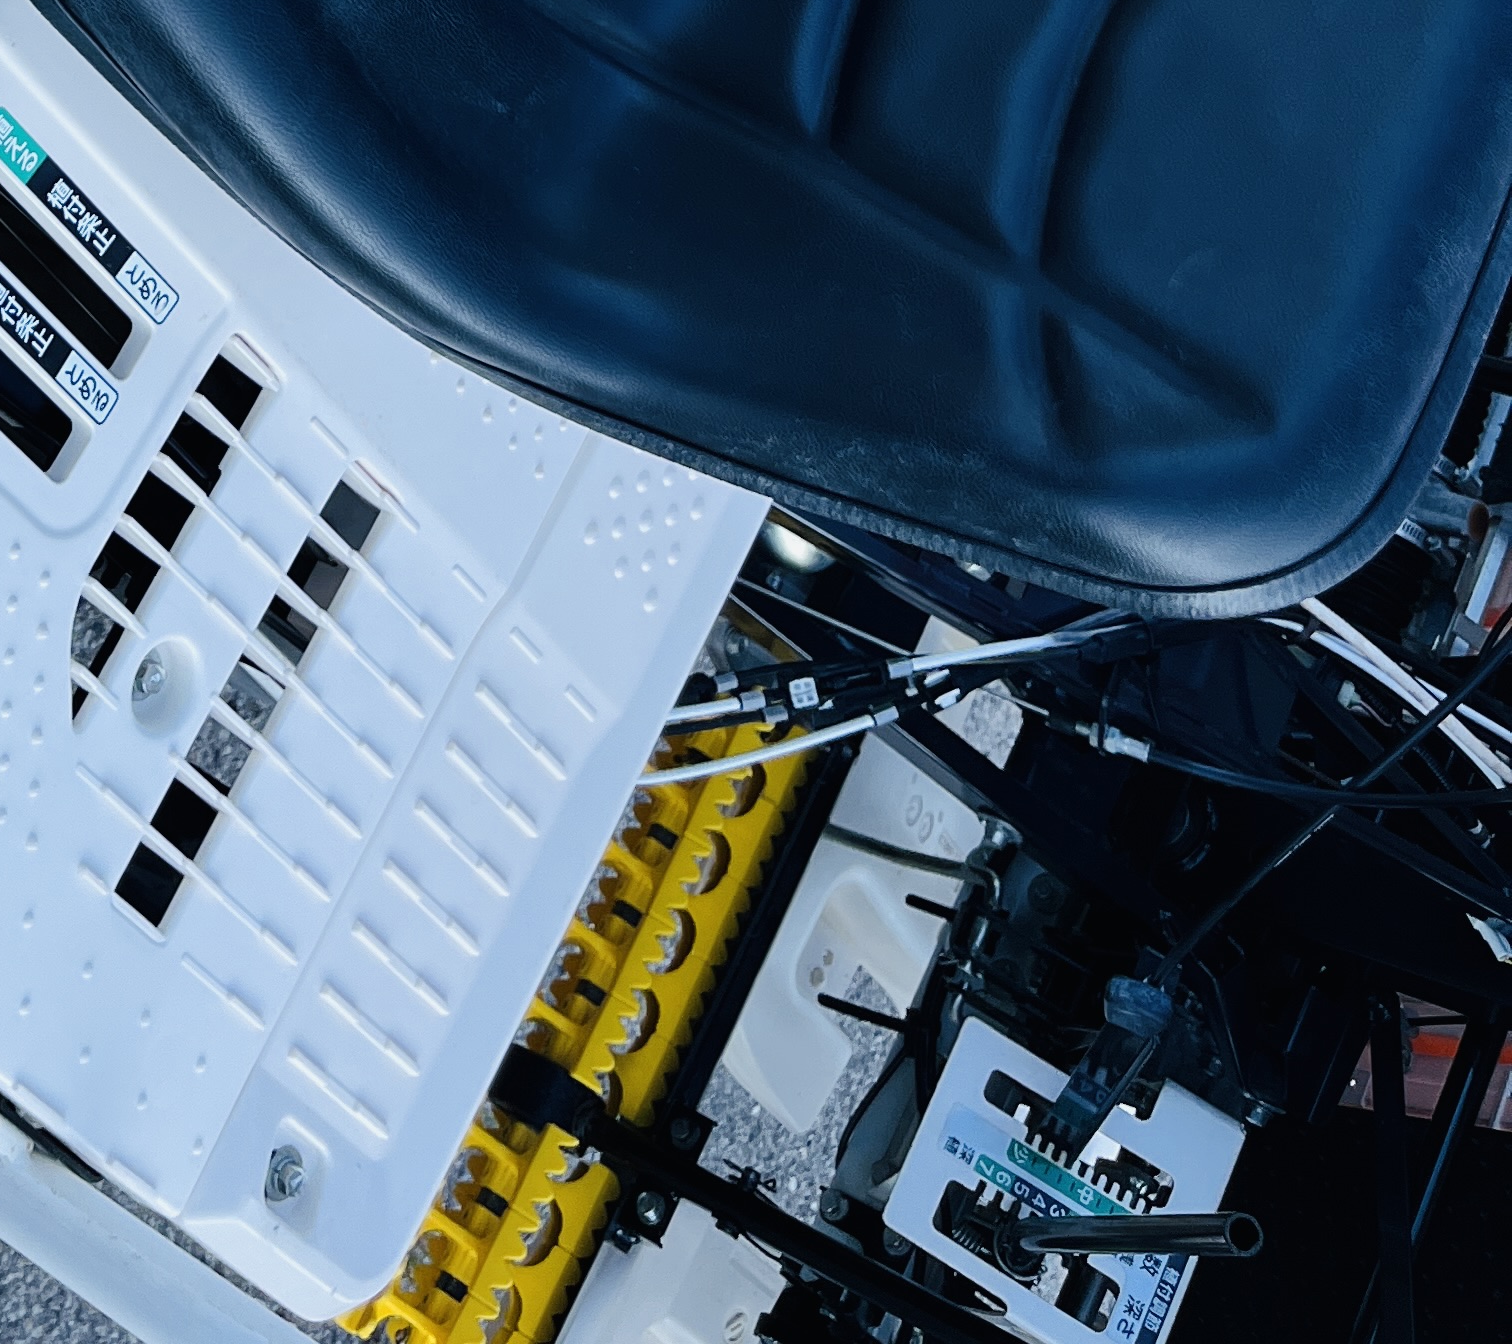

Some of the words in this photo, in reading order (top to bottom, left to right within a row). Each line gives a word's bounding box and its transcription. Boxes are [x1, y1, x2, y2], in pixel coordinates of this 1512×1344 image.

[46, 177, 116, 257] 植付条止
[66, 360, 109, 412] とめる
[977, 1159, 994, 1175] 7
[995, 1171, 1011, 1188] 6
[1013, 1181, 1031, 1198] 5
[1076, 1184, 1094, 1205] 中
[1030, 1192, 1049, 1209] 4
[1116, 1294, 1146, 1340] 深さ
